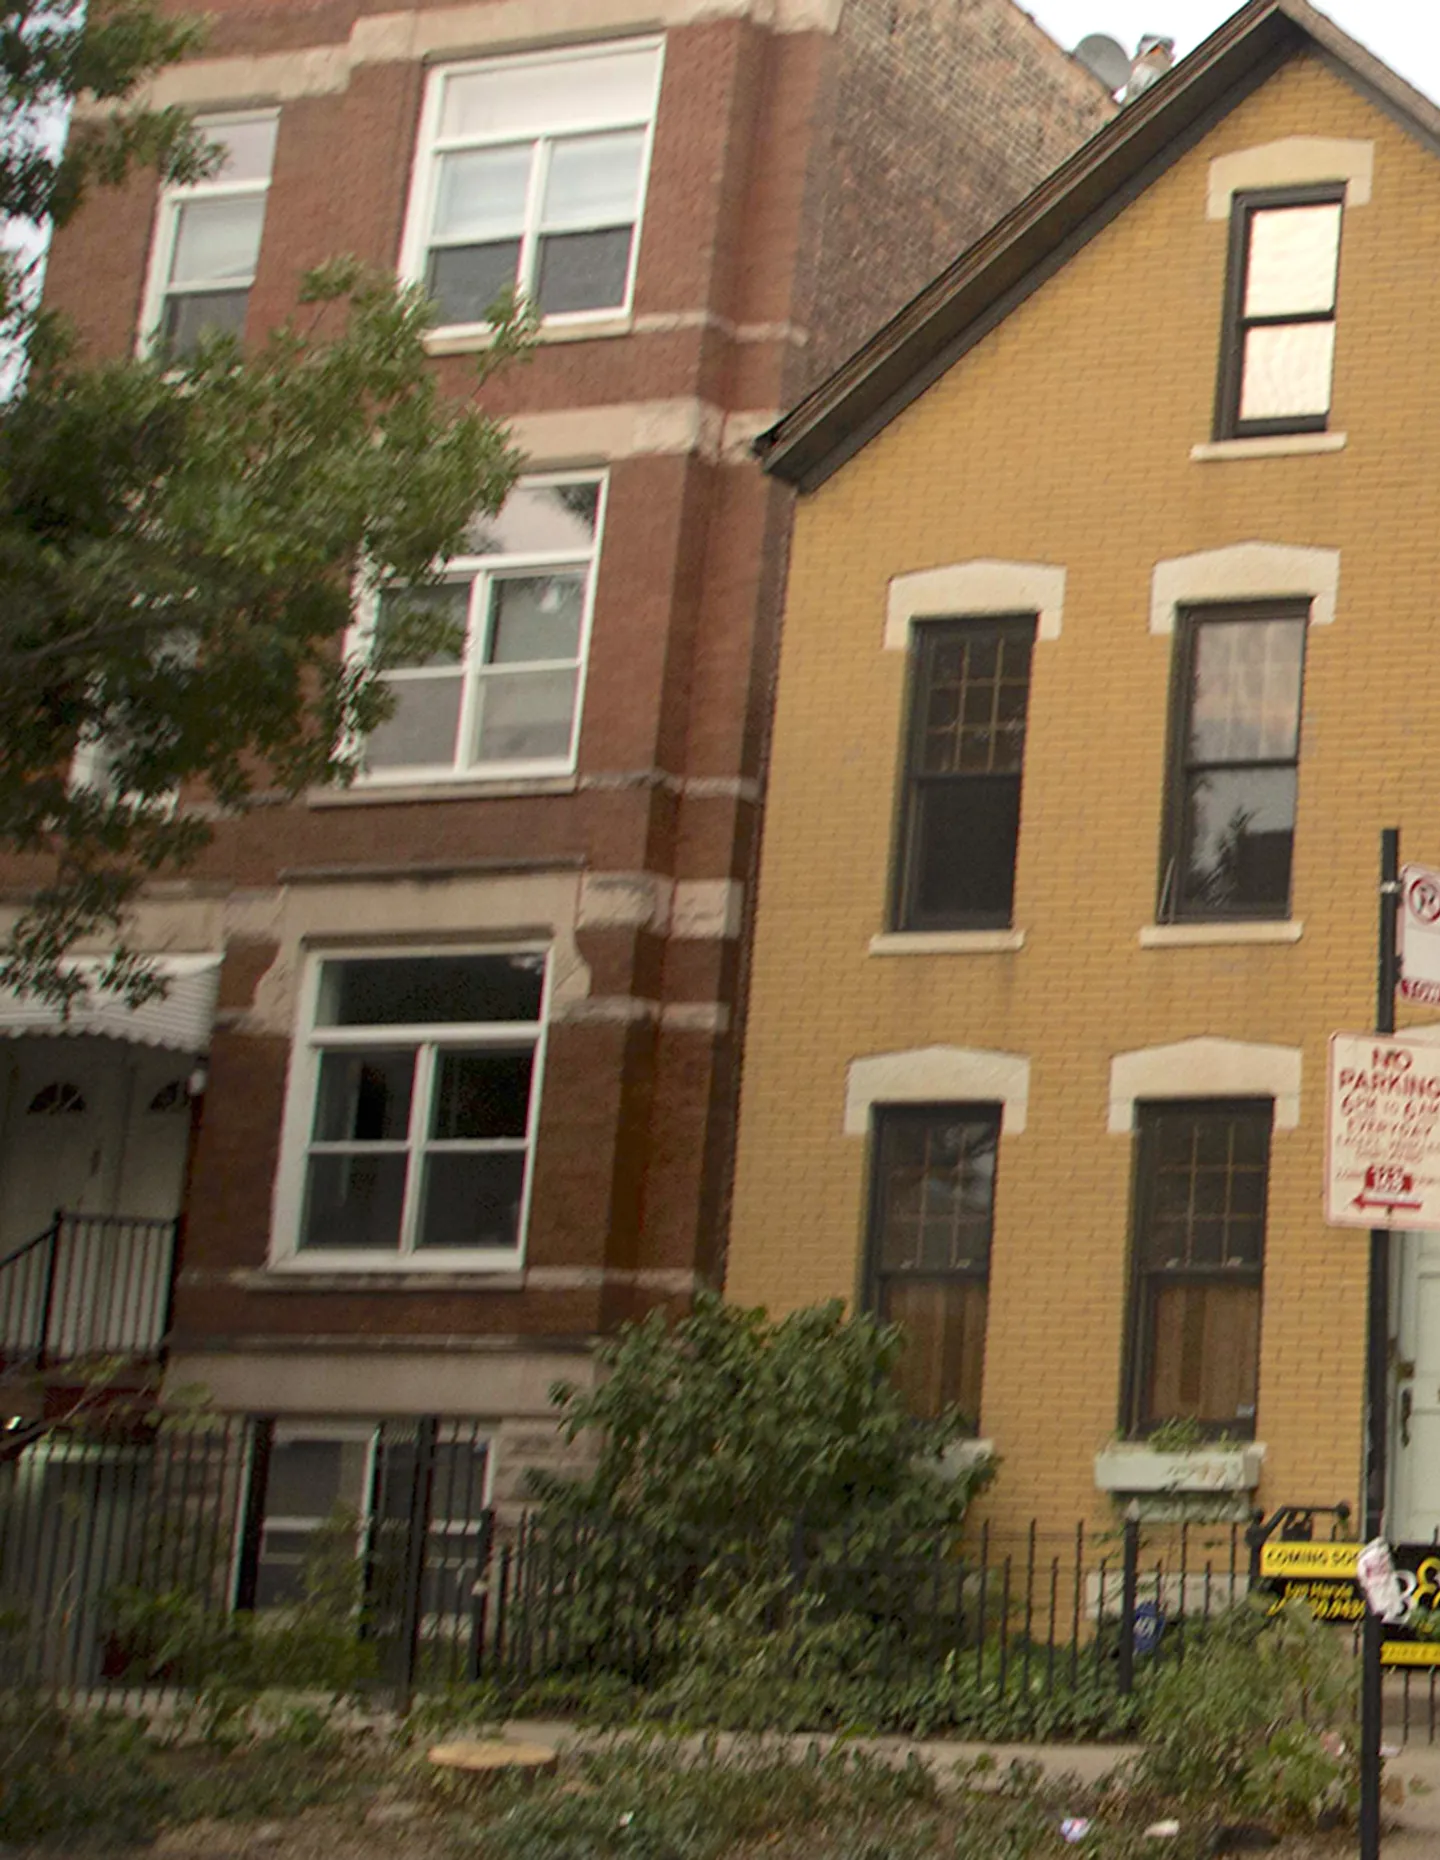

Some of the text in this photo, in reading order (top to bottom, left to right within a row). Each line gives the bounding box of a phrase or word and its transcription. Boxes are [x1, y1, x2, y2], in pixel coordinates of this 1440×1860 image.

[1407, 979, 1440, 1003] TOW
[1371, 1047, 1413, 1071] NO
[1341, 1094, 1377, 1117] 6PM
[1403, 1100, 1440, 1123] 6AM
[1347, 1116, 1434, 1138] EVERYDAY
[1264, 1547, 1329, 1567] COMING
